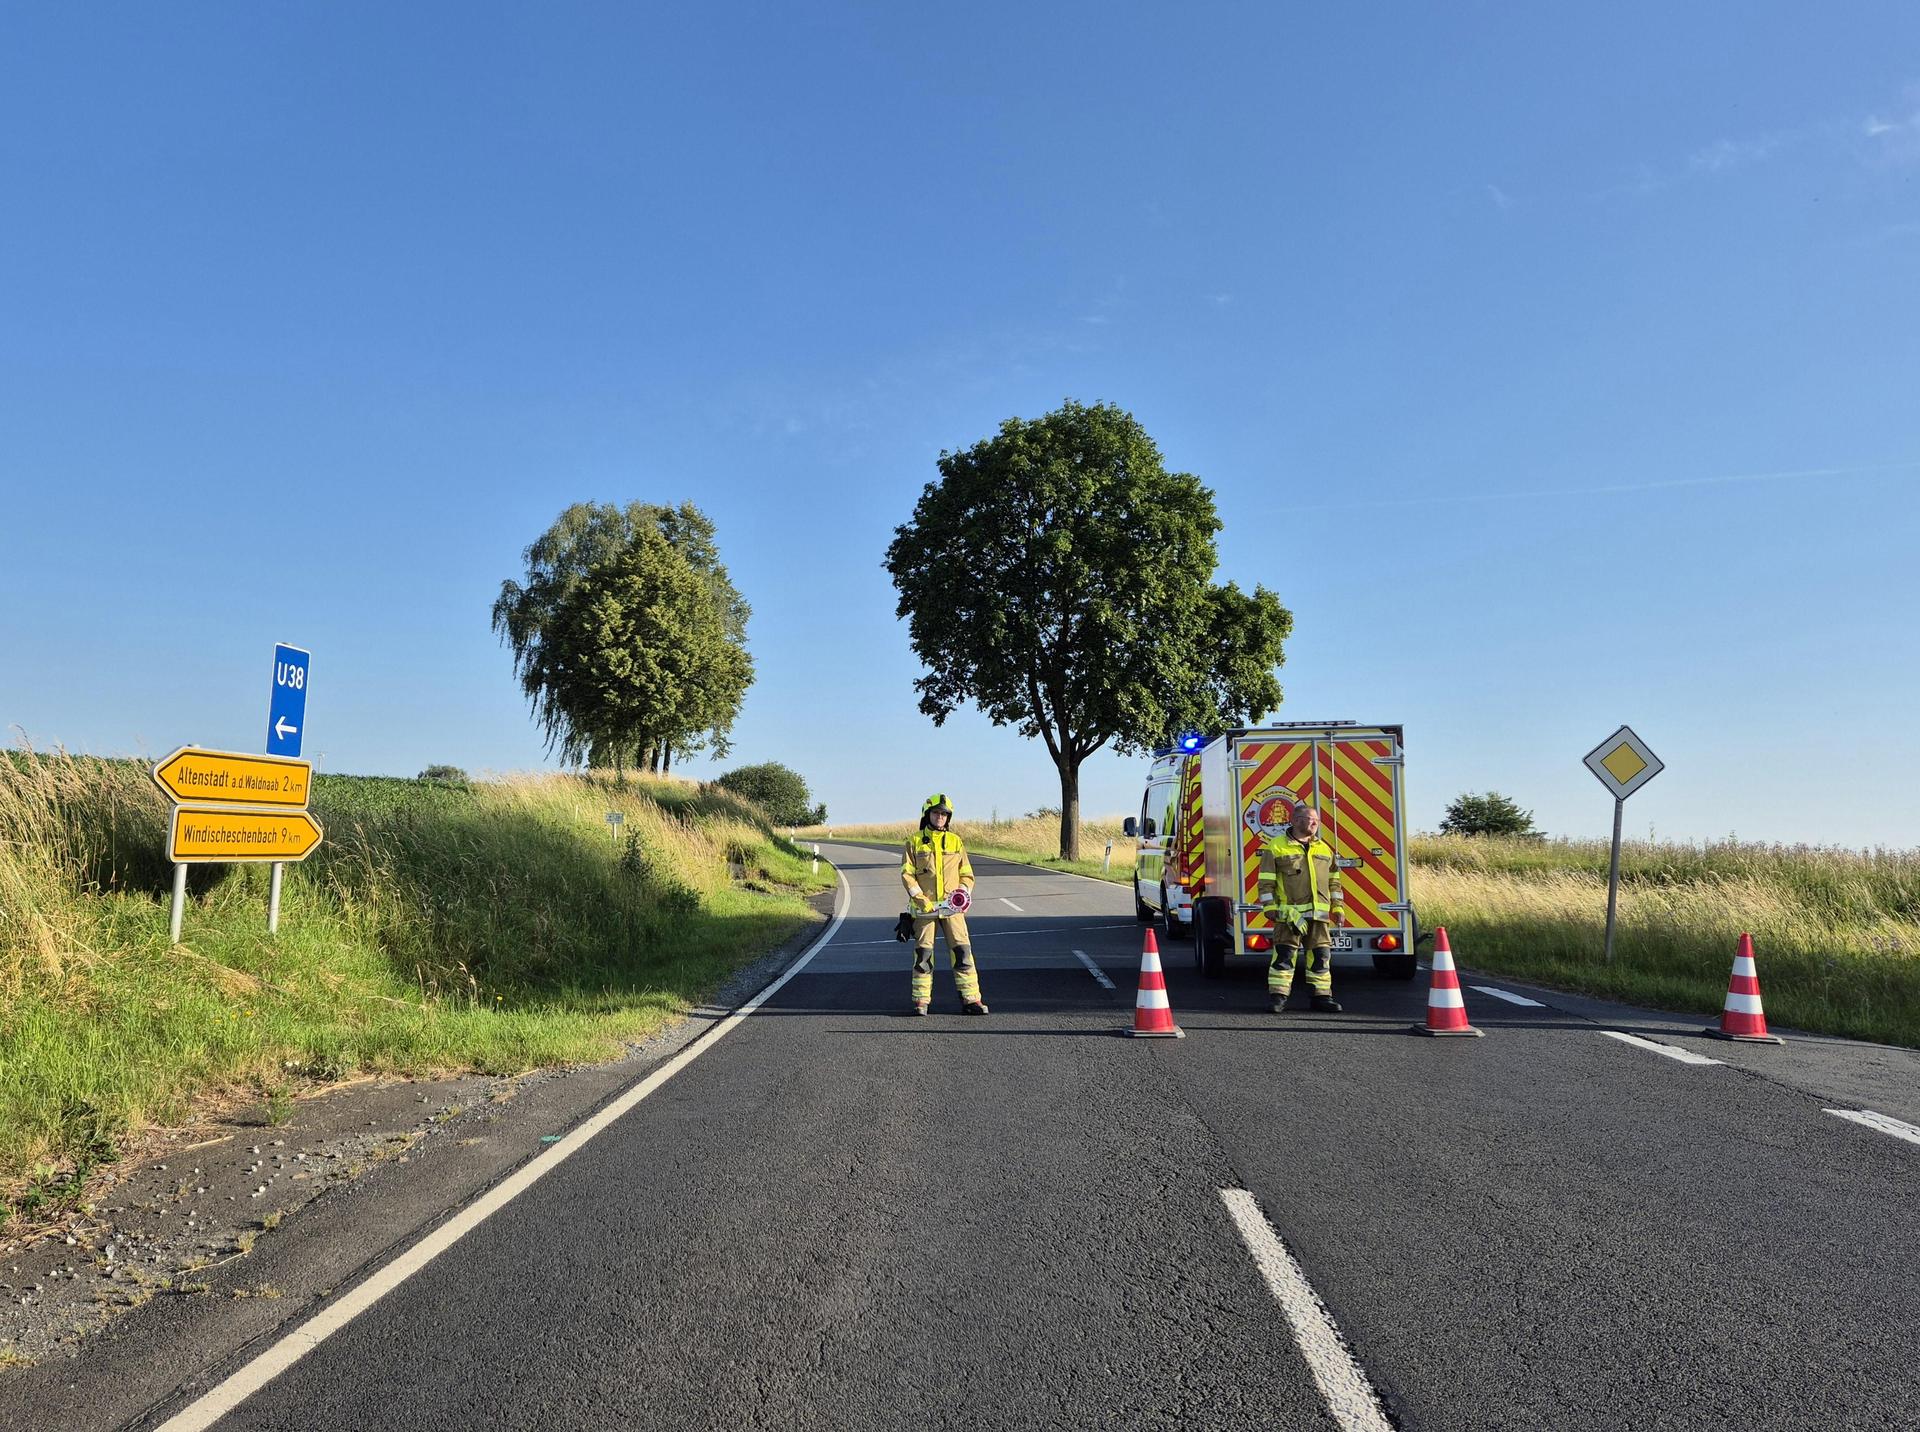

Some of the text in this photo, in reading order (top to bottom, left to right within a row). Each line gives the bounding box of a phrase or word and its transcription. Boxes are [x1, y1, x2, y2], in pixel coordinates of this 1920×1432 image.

[277, 661, 304, 690] U38
[177, 766, 229, 788] Altenstadt
[282, 775, 289, 792] 2
[290, 781, 302, 793] km
[184, 824, 301, 844] Windischeschenbach 9 km
[1338, 937, 1351, 948] 50
